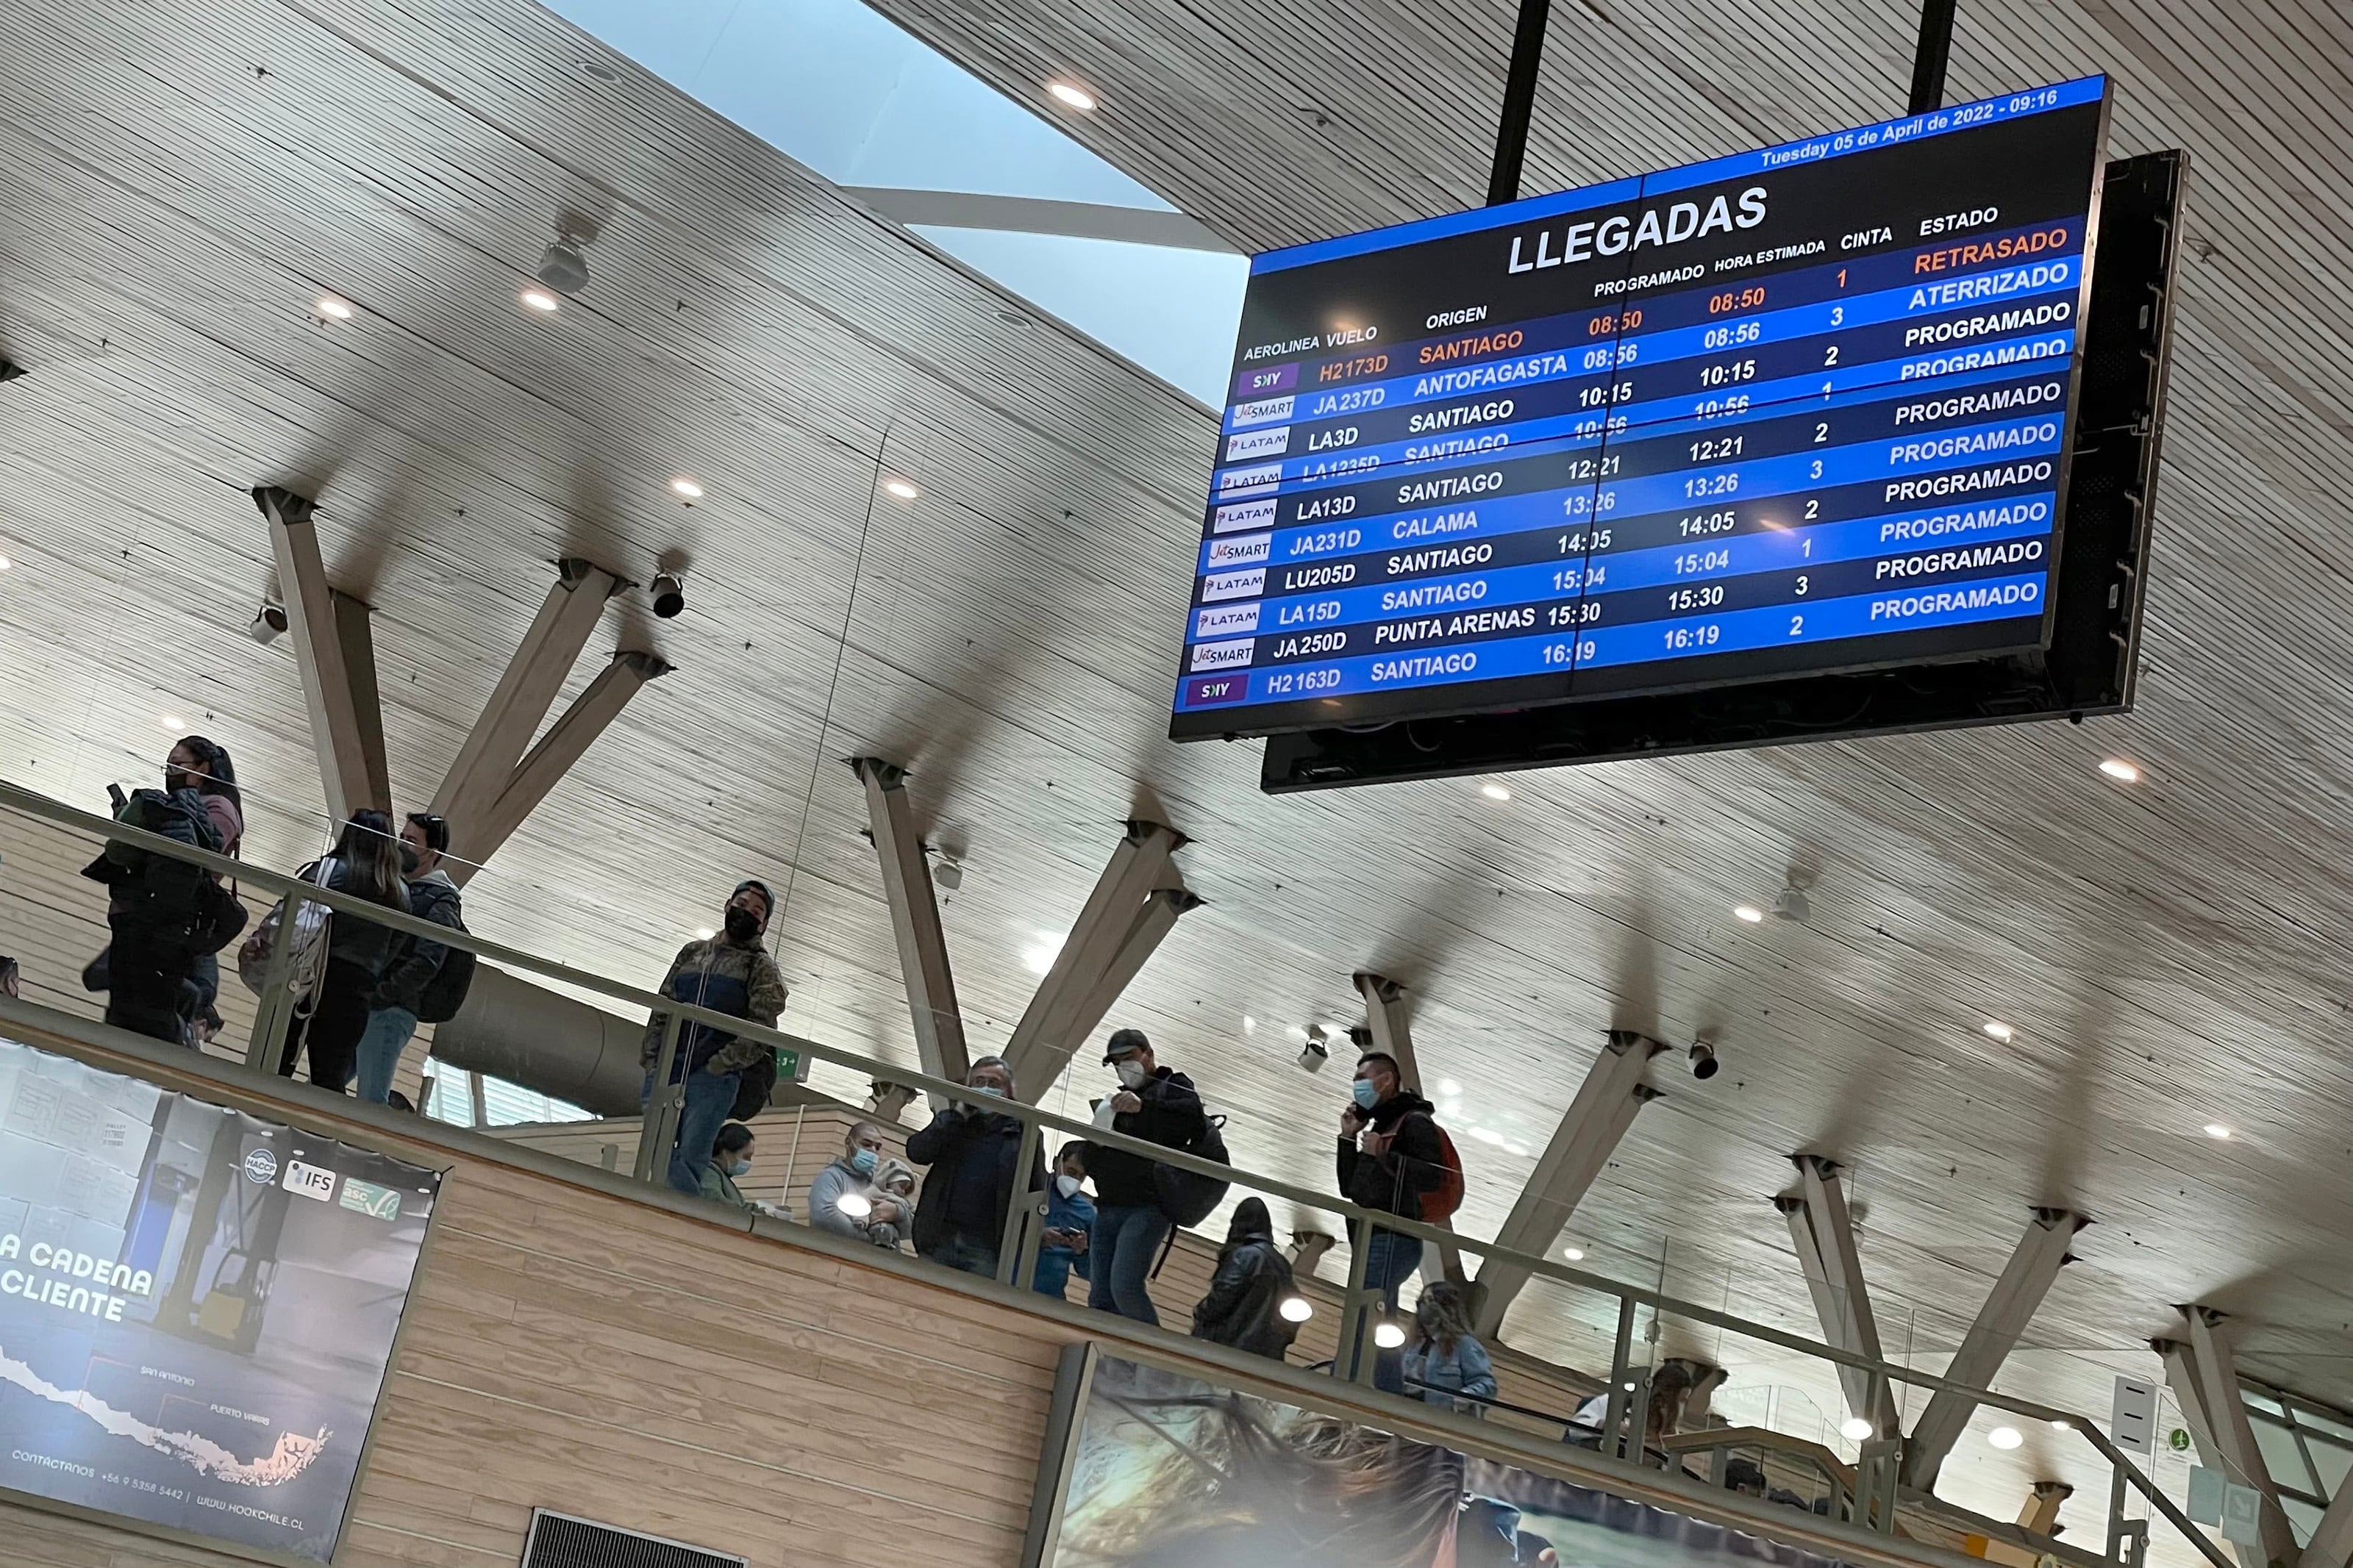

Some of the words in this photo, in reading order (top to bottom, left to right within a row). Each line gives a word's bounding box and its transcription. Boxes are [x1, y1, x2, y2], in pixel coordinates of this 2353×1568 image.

[1762, 140, 1830, 166] Tuesday
[1834, 134, 1854, 151] 05
[1857, 129, 1878, 146] de
[1882, 120, 1922, 144] April
[1927, 115, 1948, 131] de
[1952, 105, 1993, 126] 2022
[2009, 90, 2057, 113] 09:16
[1243, 336, 1320, 361] AEROLINEA
[1327, 326, 1377, 348] VUELO
[1426, 305, 1487, 330] ORIGEN
[1594, 265, 1704, 297] PROGRAMADO
[1714, 256, 1752, 272] HORA
[1756, 240, 1825, 265] ESTIMADA
[1840, 226, 1893, 251] CINTA
[1919, 207, 1999, 236] ESTADO
[1508, 187, 1767, 273] LLEGADAS
[1313, 388, 1385, 415] JA237D
[1414, 354, 1567, 397] ANTOFAGASTA
[1583, 344, 1638, 370] 08:56
[1704, 322, 1760, 349] 08:56
[1831, 307, 1844, 327] 3
[1909, 263, 2068, 309] ATERRIZADO
[1319, 355, 1388, 382] H2173D
[1419, 331, 1523, 364] SANTIAGO
[1589, 310, 1643, 336] 08:50
[1710, 287, 1765, 314] 08:50
[1838, 269, 1846, 288] 1
[1915, 228, 2068, 274] RETRASADO
[1234, 472, 1279, 487] LATAM
[1404, 434, 1509, 465] SANTIAGO
[1574, 415, 1627, 441] 10:56
[1695, 395, 1749, 421] 10:56
[1822, 382, 1832, 401] 1
[1901, 339, 2066, 381] PROGRAMADO
[1240, 434, 1287, 449] LATAM
[1309, 427, 1358, 451] LA3D
[1409, 400, 1514, 433] SANTIAGO
[1579, 382, 1632, 407] 10:15
[1700, 359, 1756, 386] 10:15
[1824, 346, 1838, 367] 2
[1904, 302, 2070, 347] PROGRAMADO
[1228, 506, 1274, 522] LATAM
[1296, 495, 1356, 520] LA13D
[1398, 471, 1503, 504] SANTIAGO
[1568, 455, 1620, 480] 12:21
[1690, 435, 1743, 462] 12:21
[1815, 422, 1829, 443] 2
[1896, 382, 2060, 425] PROGRAMADO
[1290, 529, 1361, 556] JA231D
[1393, 511, 1477, 540] CALAMA
[1563, 492, 1615, 515] 13:26
[1685, 473, 1739, 498] 13:26
[1810, 459, 1823, 480] 3
[1890, 423, 2057, 465] PROGRAMADO
[1210, 612, 1257, 626] LATAM
[1279, 601, 1341, 625] LA15D
[1382, 580, 1488, 611] SANTIAGO
[1553, 566, 1606, 591] 15:04
[1674, 549, 1729, 575] 15:04
[1802, 538, 1812, 558] 1
[1880, 502, 2047, 543] PROGRAMADO
[1216, 576, 1263, 590] LATAM
[1285, 564, 1356, 589] LU205D
[1387, 544, 1493, 575] SANTIAGO
[1558, 529, 1612, 554] 14:05
[1679, 511, 1735, 537] 14:05
[1804, 499, 1818, 520] 2
[1885, 462, 2052, 503] PROGRAMADO
[1268, 669, 1341, 694] H2163D
[1371, 653, 1477, 681] SANTIAGO
[1543, 640, 1596, 664] 16:19
[1664, 625, 1719, 649] 16:19
[1790, 615, 1804, 636] 2
[1871, 582, 2038, 620] PROGRAMADO
[1274, 631, 1347, 659] JA250D
[1375, 618, 1443, 644] PUNTA
[1448, 607, 1535, 636] ARENAS
[1548, 602, 1601, 626] 15:30
[1668, 586, 1724, 611] 15:30
[1796, 576, 1809, 595] 3
[1876, 541, 2042, 580] PROGRAMADO
[247, 1159, 275, 1173] HACCP
[305, 1172, 331, 1191] IFS
[343, 1186, 368, 1202] asc
[0, 1270, 126, 1322] CLIENTE
[29, 1242, 152, 1295] CADENA
[140, 1366, 157, 1377] SAN
[159, 1370, 194, 1386] ANTONIO
[210, 1404, 241, 1419] PUERTO
[243, 1412, 270, 1426] VARAS
[102, 1472, 119, 1483] +56
[123, 1477, 129, 1486] 9
[132, 1479, 156, 1493] 5358
[159, 1486, 183, 1500] 5442
[196, 1495, 304, 1531] WWW.HOOKCHILE.CL
